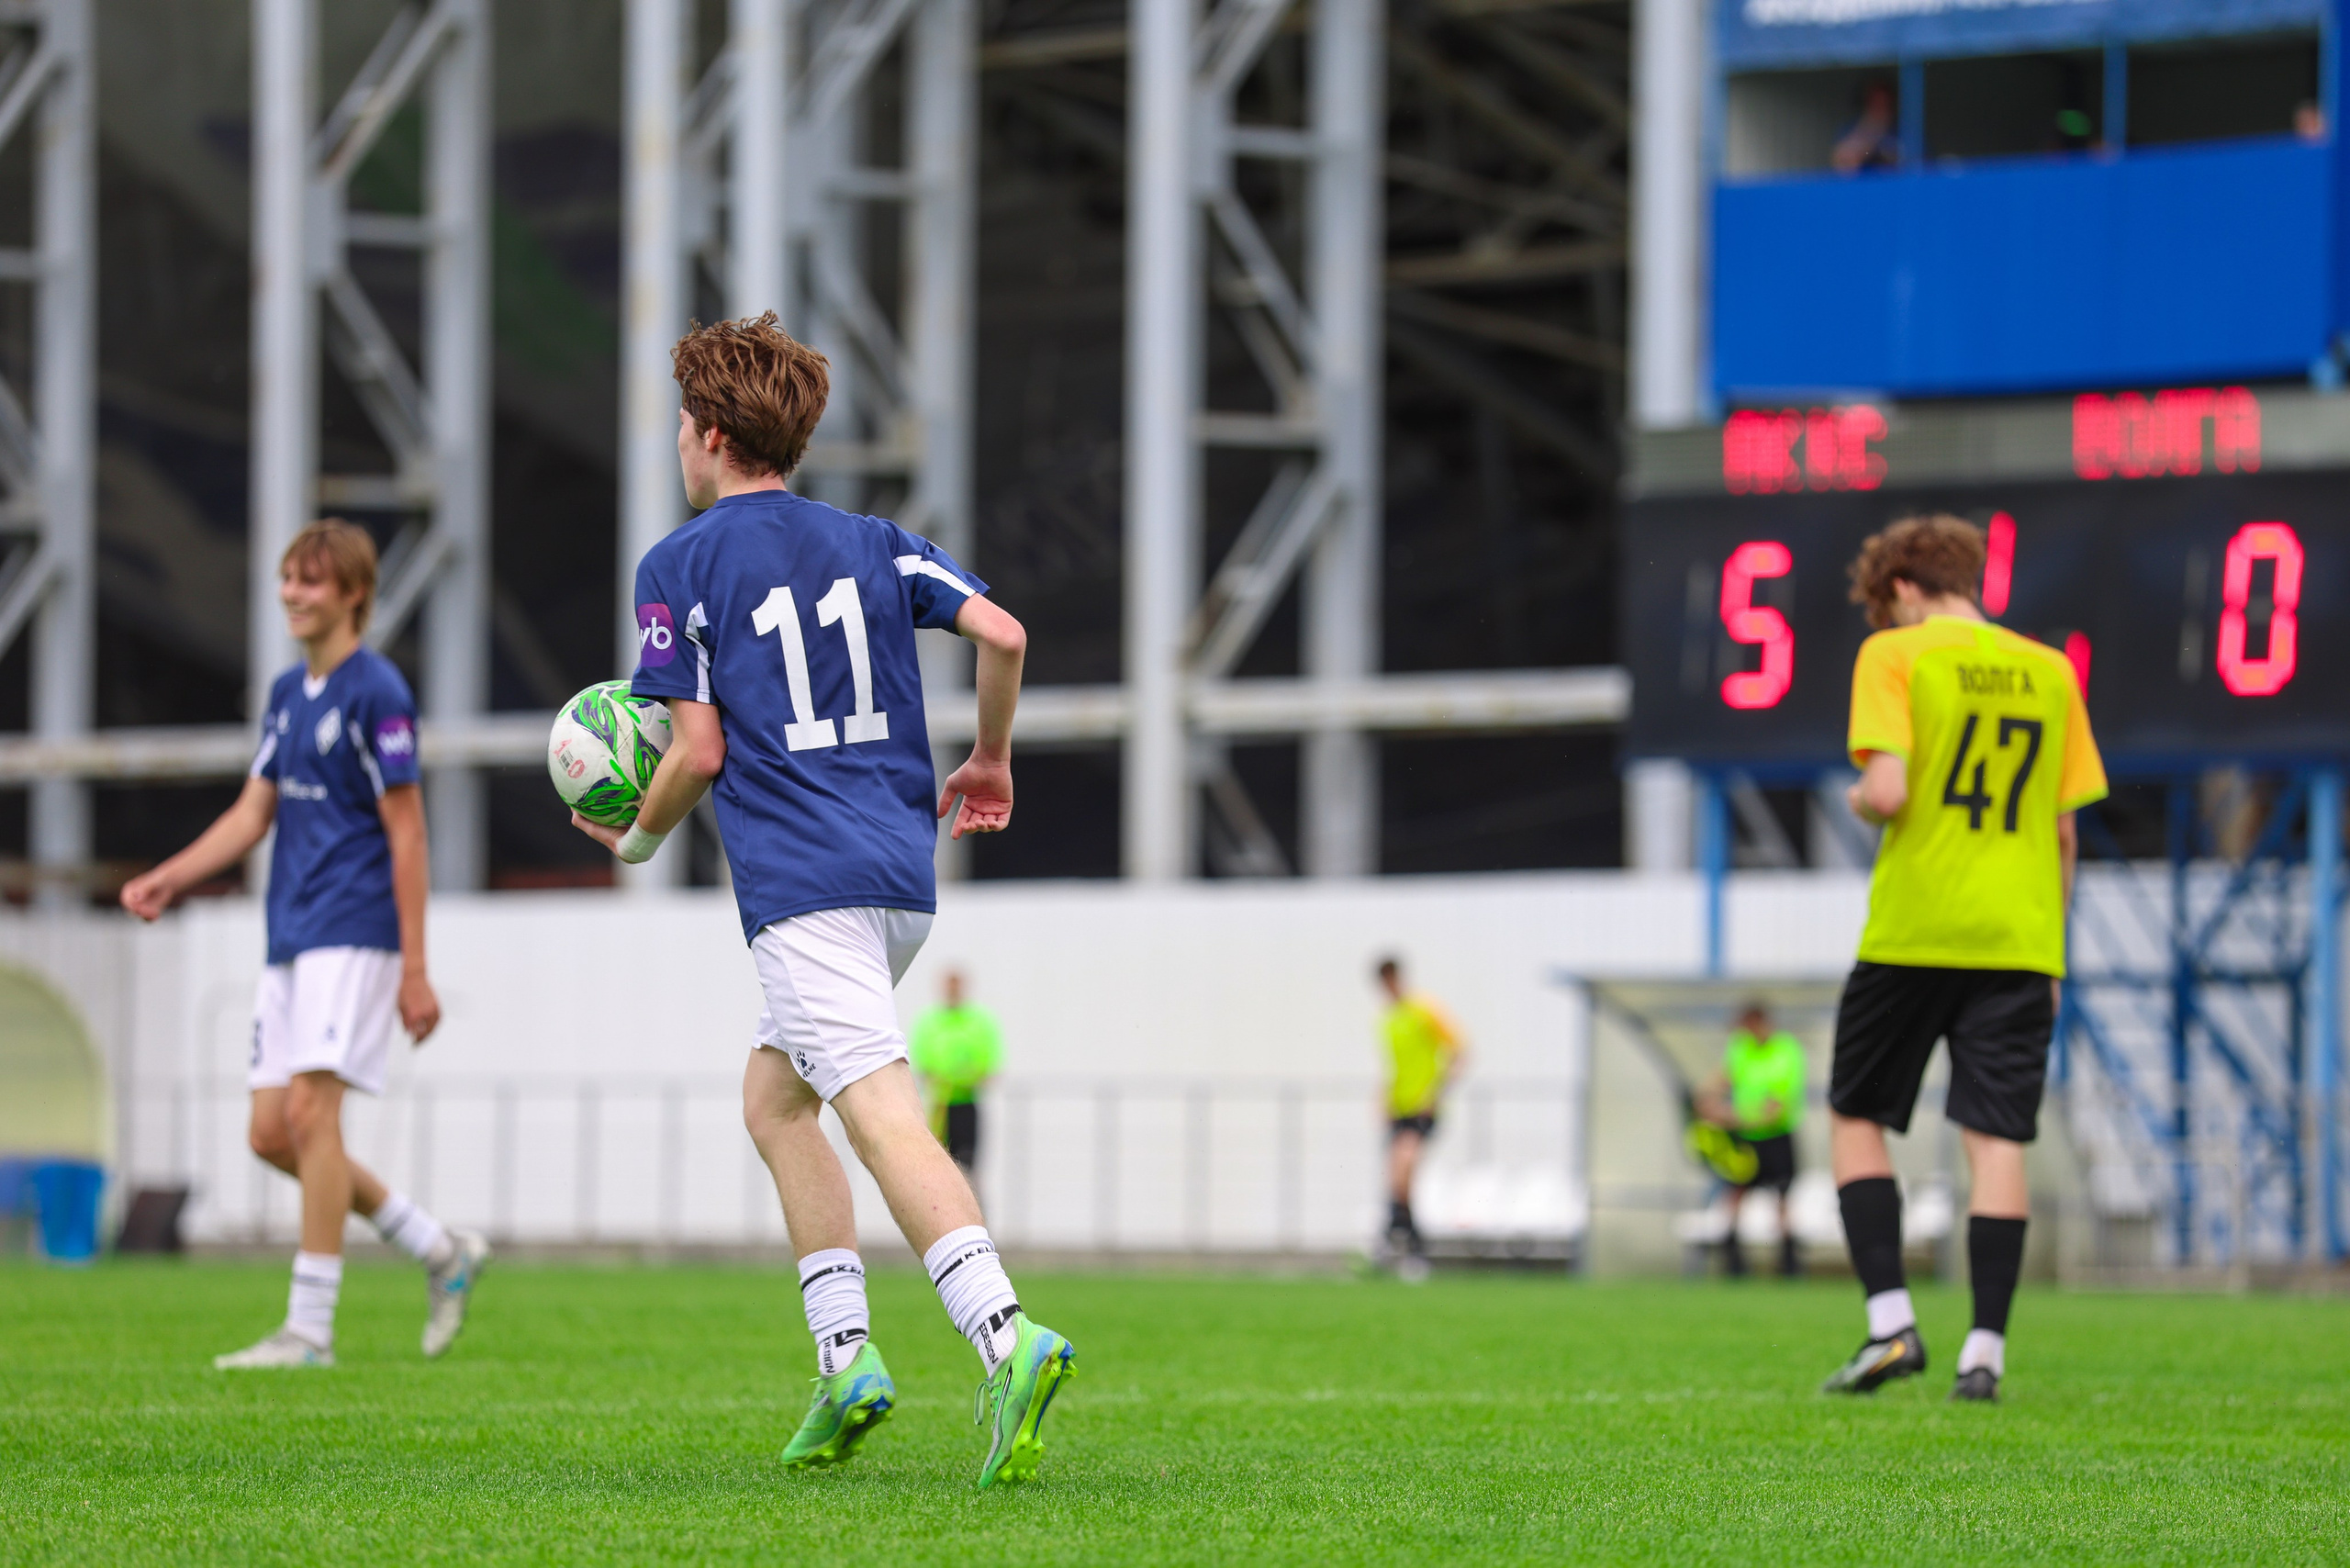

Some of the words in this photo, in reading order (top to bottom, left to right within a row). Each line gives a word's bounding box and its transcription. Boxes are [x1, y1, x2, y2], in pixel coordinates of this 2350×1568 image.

[751, 577, 890, 752] 11
[1720, 541, 1794, 710] 5
[2217, 521, 2303, 696] 0
[1942, 713, 2042, 833] 47
